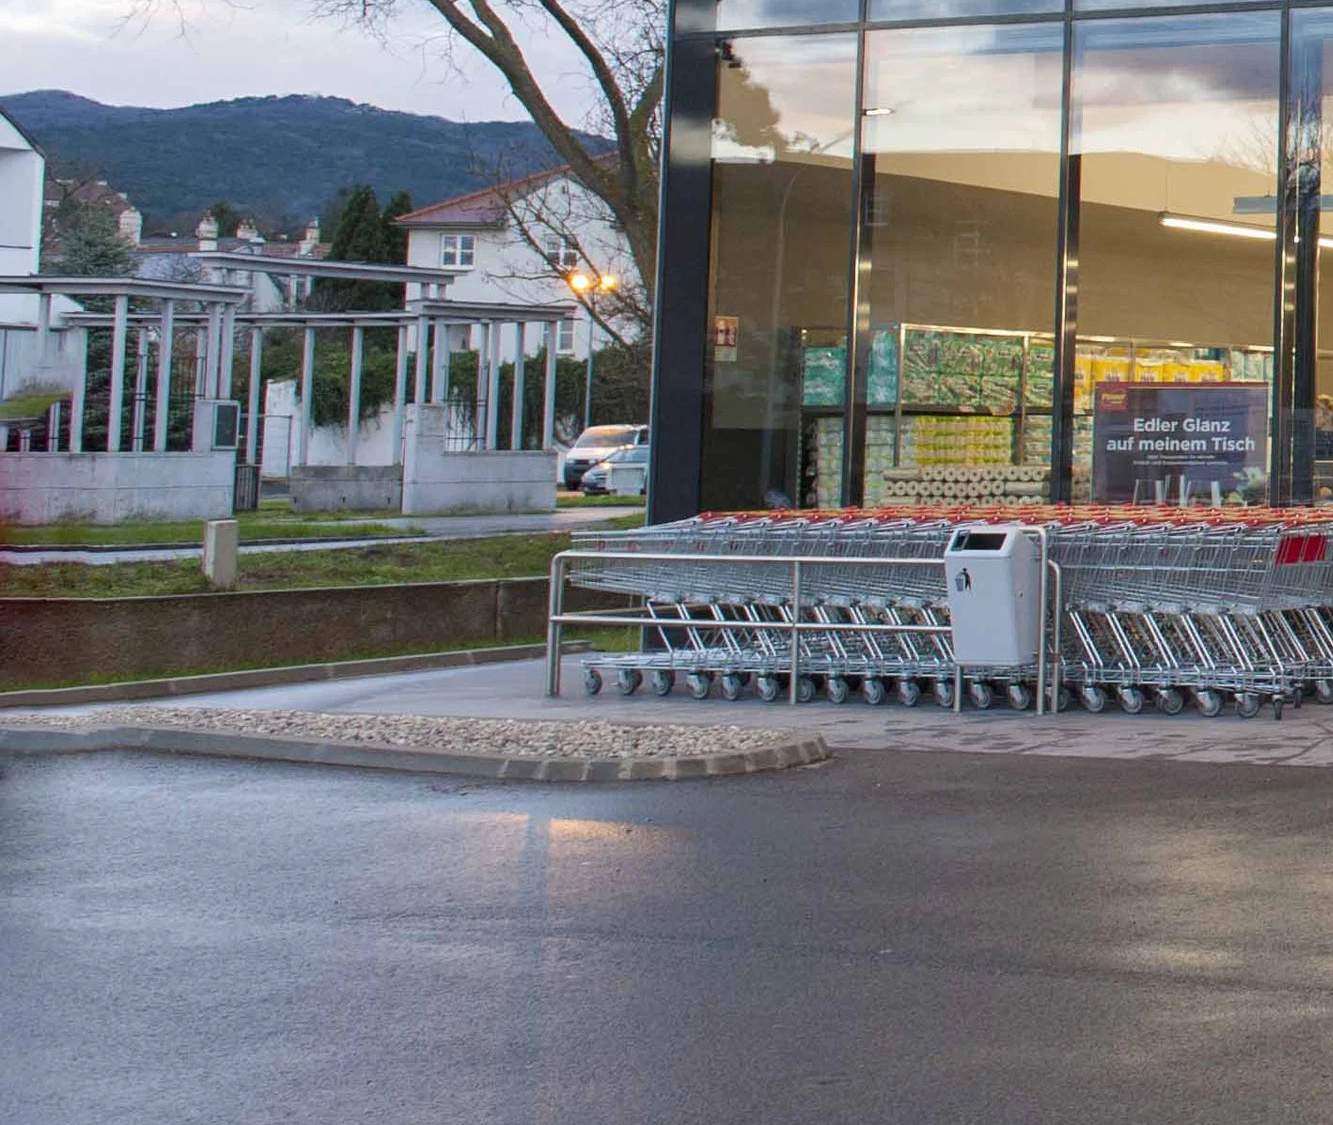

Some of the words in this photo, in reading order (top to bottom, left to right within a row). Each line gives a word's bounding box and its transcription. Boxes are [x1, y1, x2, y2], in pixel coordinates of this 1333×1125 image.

[1133, 418, 1178, 432] Edler
[1183, 418, 1231, 432] Glanz
[1106, 437, 1135, 451] auf
[1138, 437, 1207, 451] meinem
[1211, 436, 1255, 451] Tisch
